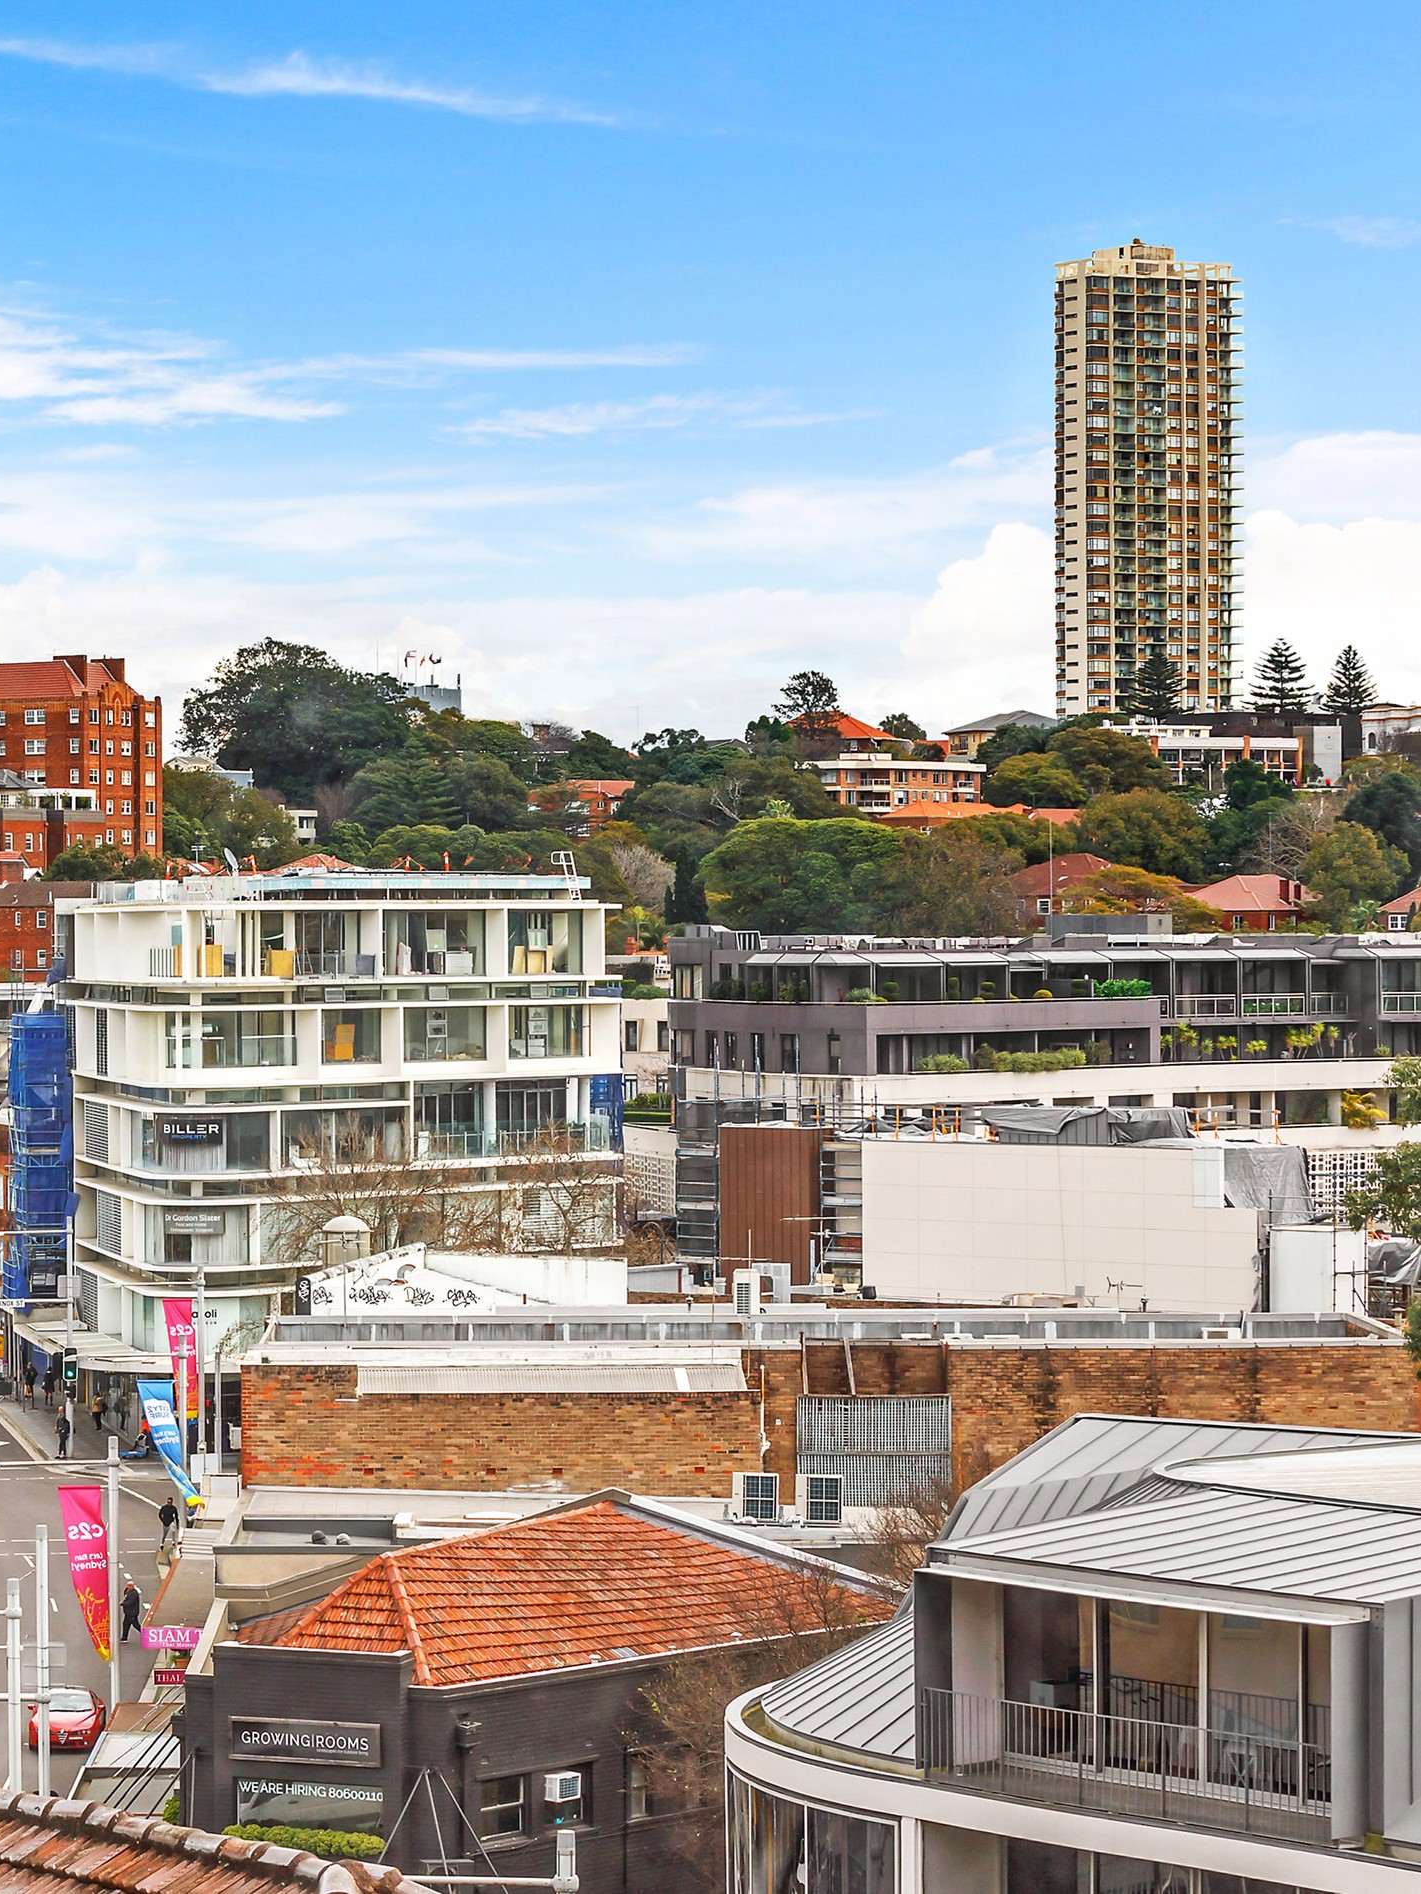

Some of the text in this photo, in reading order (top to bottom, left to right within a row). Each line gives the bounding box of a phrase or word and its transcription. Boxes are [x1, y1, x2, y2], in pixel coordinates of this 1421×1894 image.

[163, 1124, 219, 1134] BILLER
[148, 1629, 191, 1643] SIAM
[155, 1674, 180, 1682] THAI
[239, 1781, 383, 1801] WE ARE HIRING 80600110
